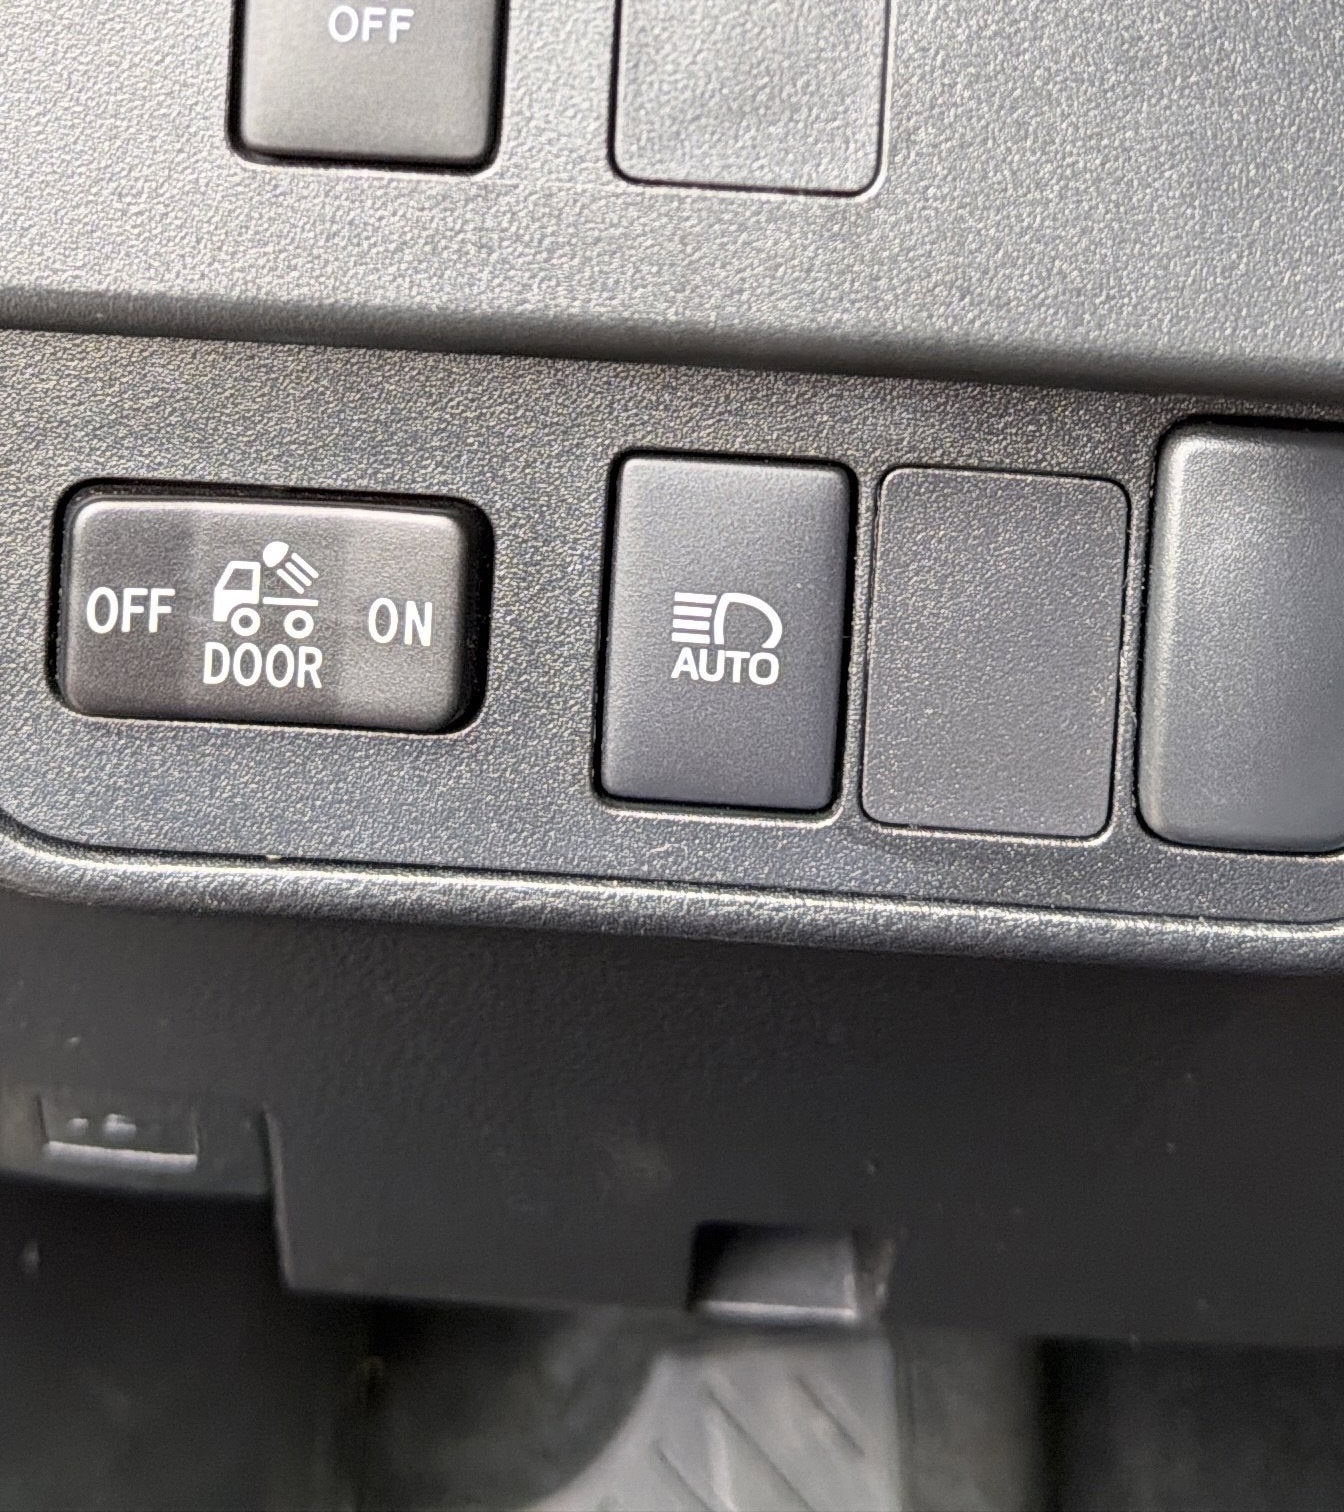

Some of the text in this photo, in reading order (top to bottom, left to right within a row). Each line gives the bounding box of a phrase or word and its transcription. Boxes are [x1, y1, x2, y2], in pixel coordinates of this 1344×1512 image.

[327, 4, 415, 44] OFF
[86, 586, 176, 634] OFF
[368, 597, 433, 647] ON
[203, 641, 323, 689] DOOR
[670, 647, 780, 686] AUTO
